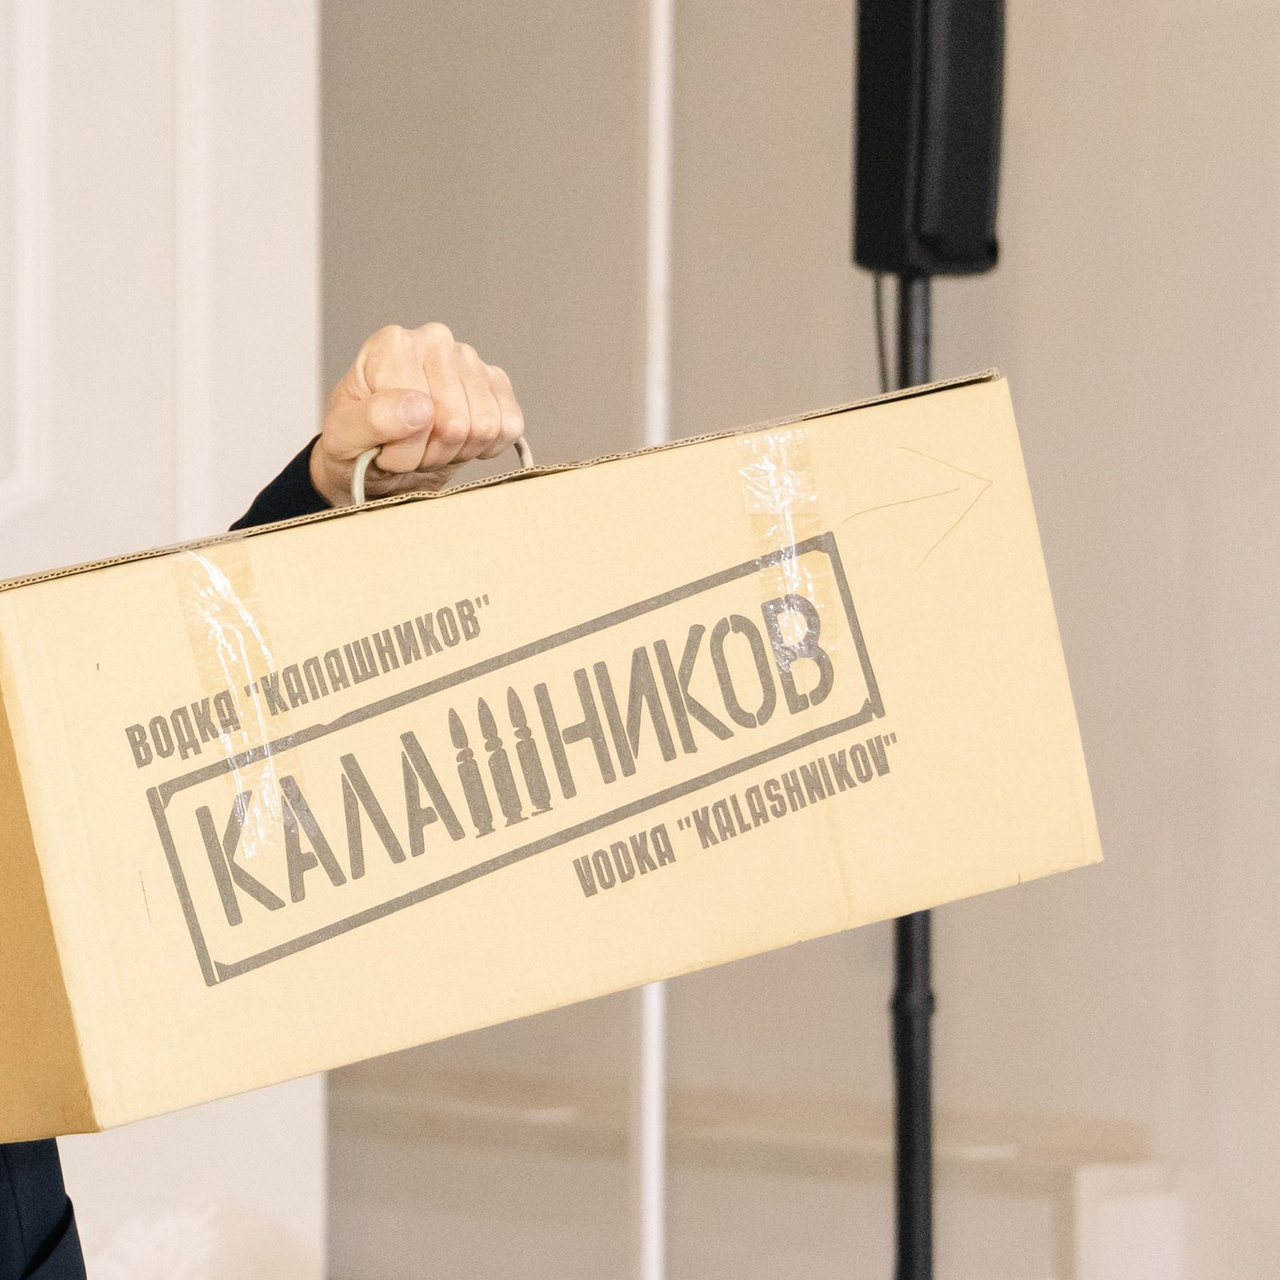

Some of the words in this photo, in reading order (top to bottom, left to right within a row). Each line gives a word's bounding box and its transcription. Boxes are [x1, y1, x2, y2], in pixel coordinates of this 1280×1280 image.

[125, 689, 241, 769] ВОДКА
[195, 594, 835, 927] КАЛАШНИКОВ
[572, 823, 677, 898] VODKA
[677, 732, 898, 850] "KALASHNIKOV"
